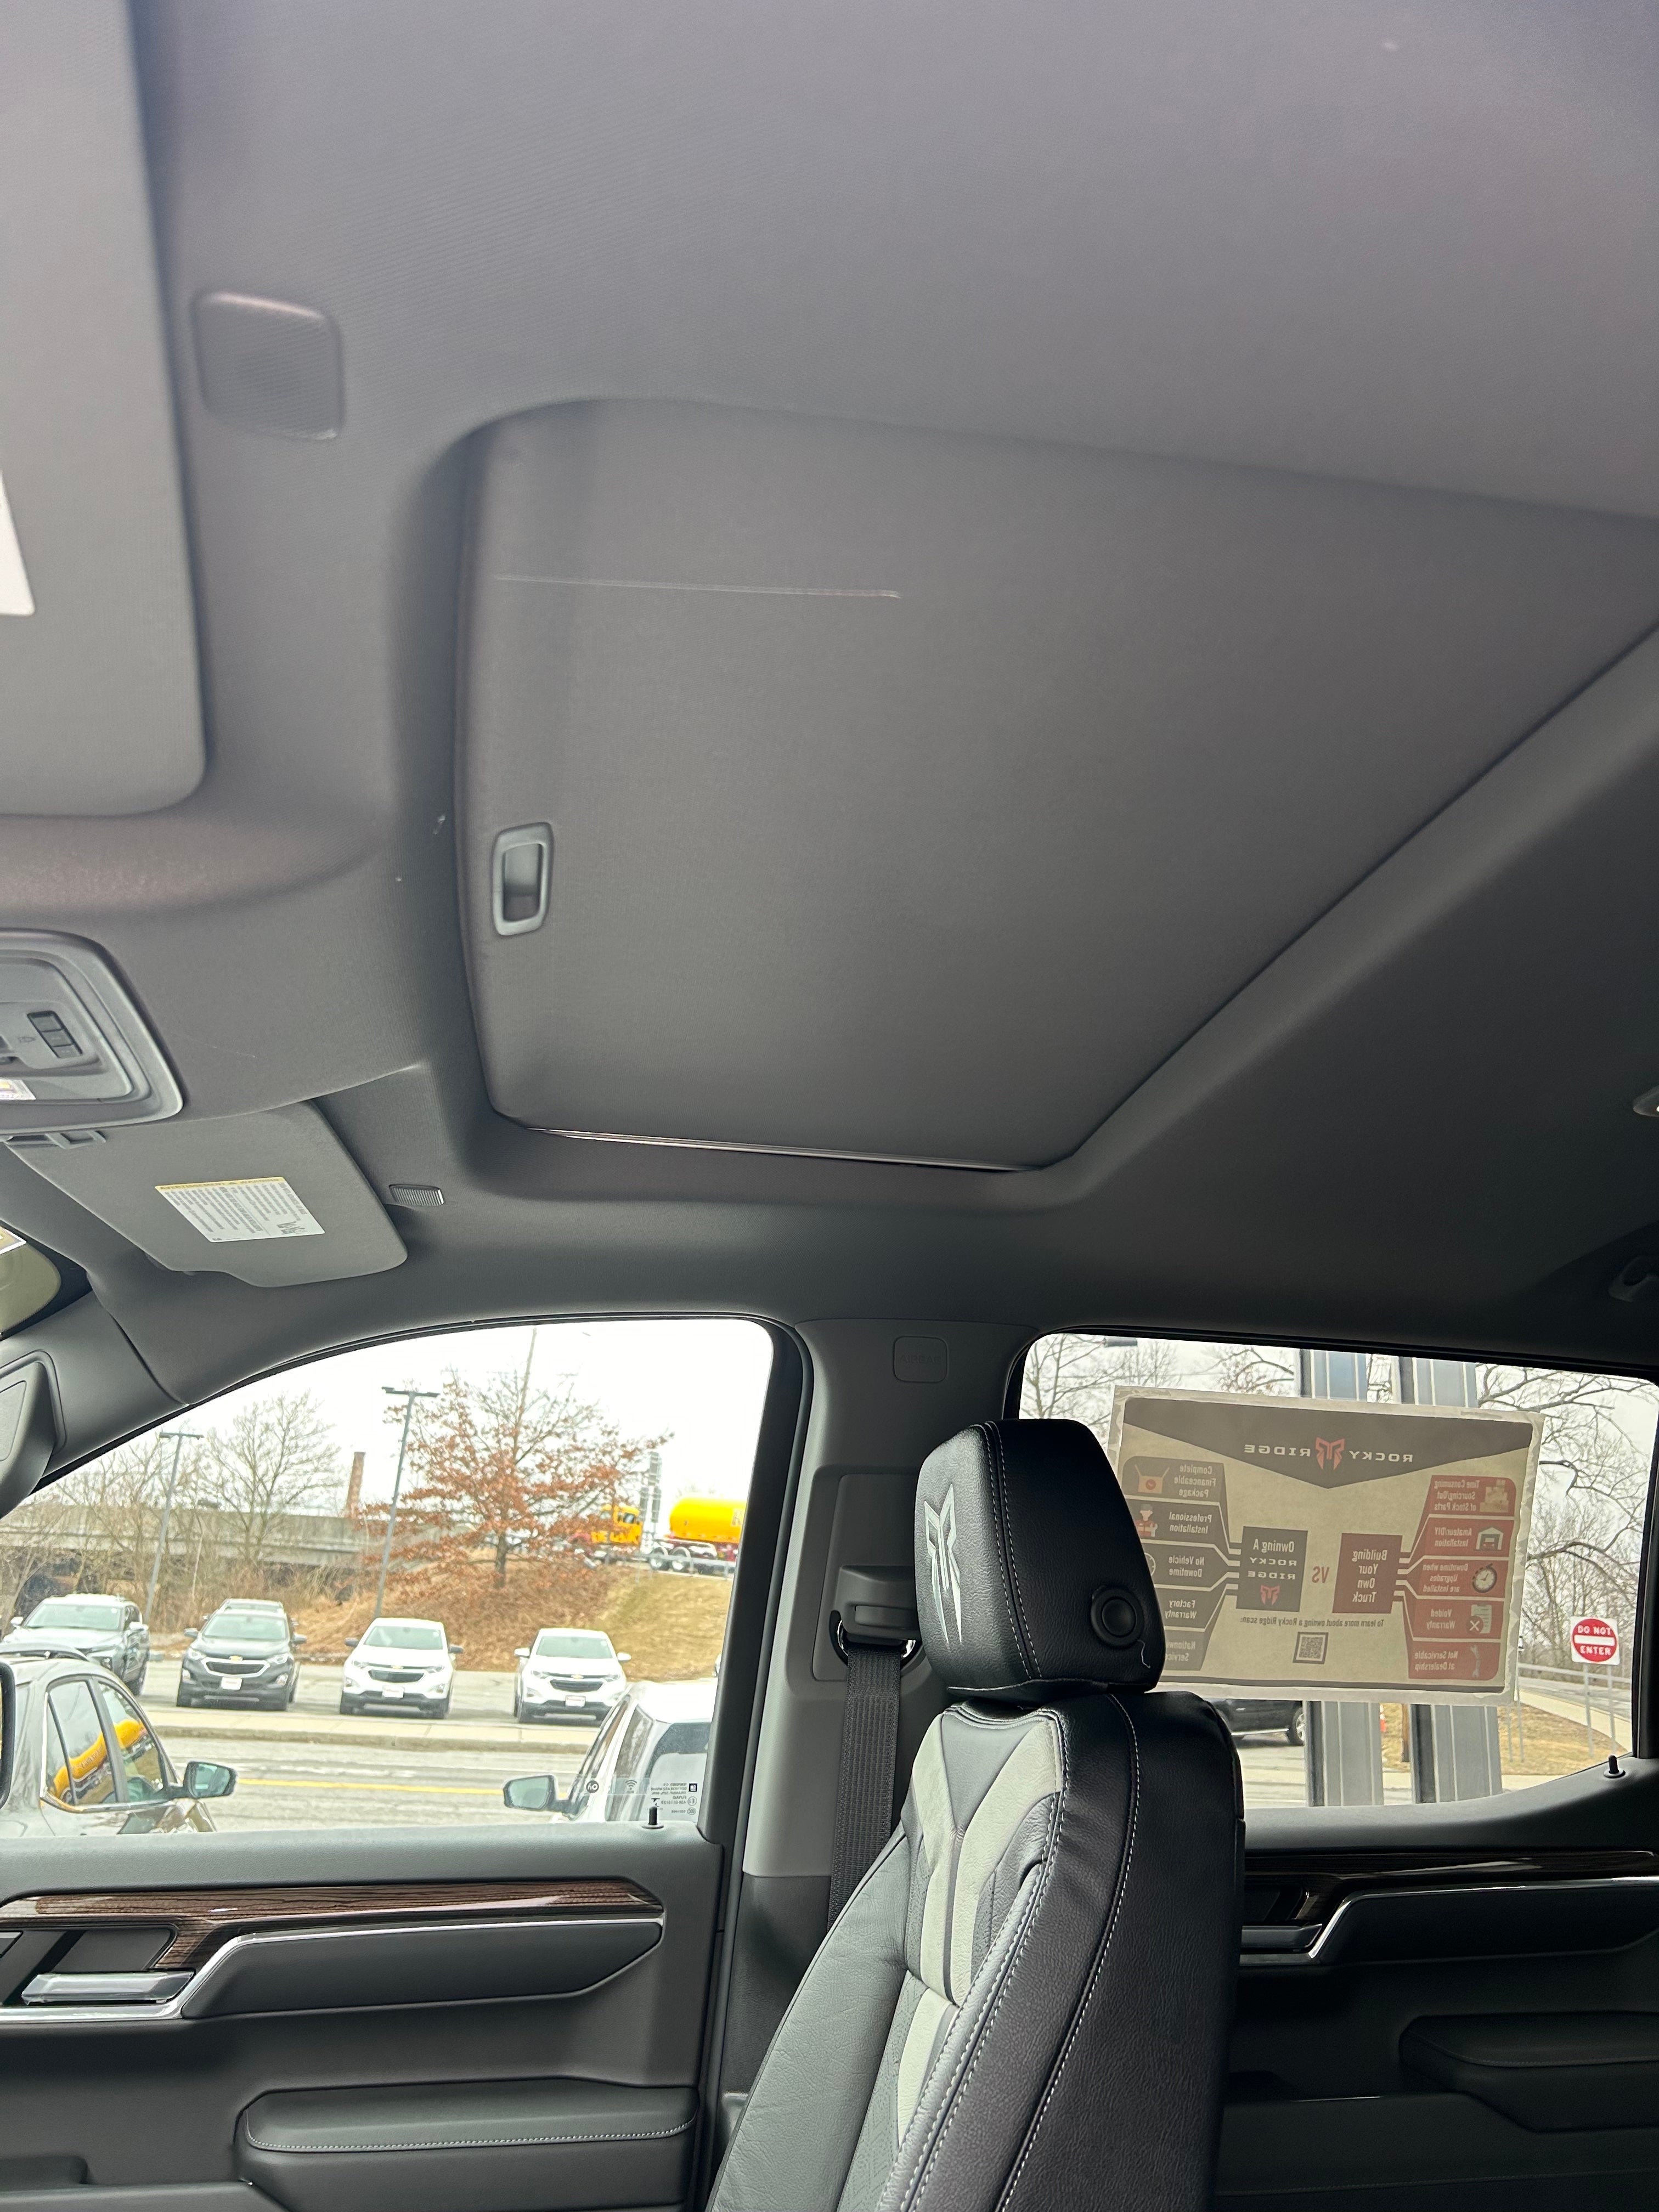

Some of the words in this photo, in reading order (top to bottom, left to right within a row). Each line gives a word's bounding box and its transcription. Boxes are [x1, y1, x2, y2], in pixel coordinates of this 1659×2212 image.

[899, 1355, 942, 1364] AIRBAG
[1577, 1625, 1590, 1634] DO
[1593, 1626, 1611, 1635] NOT
[1580, 1645, 1611, 1656] ENTER
